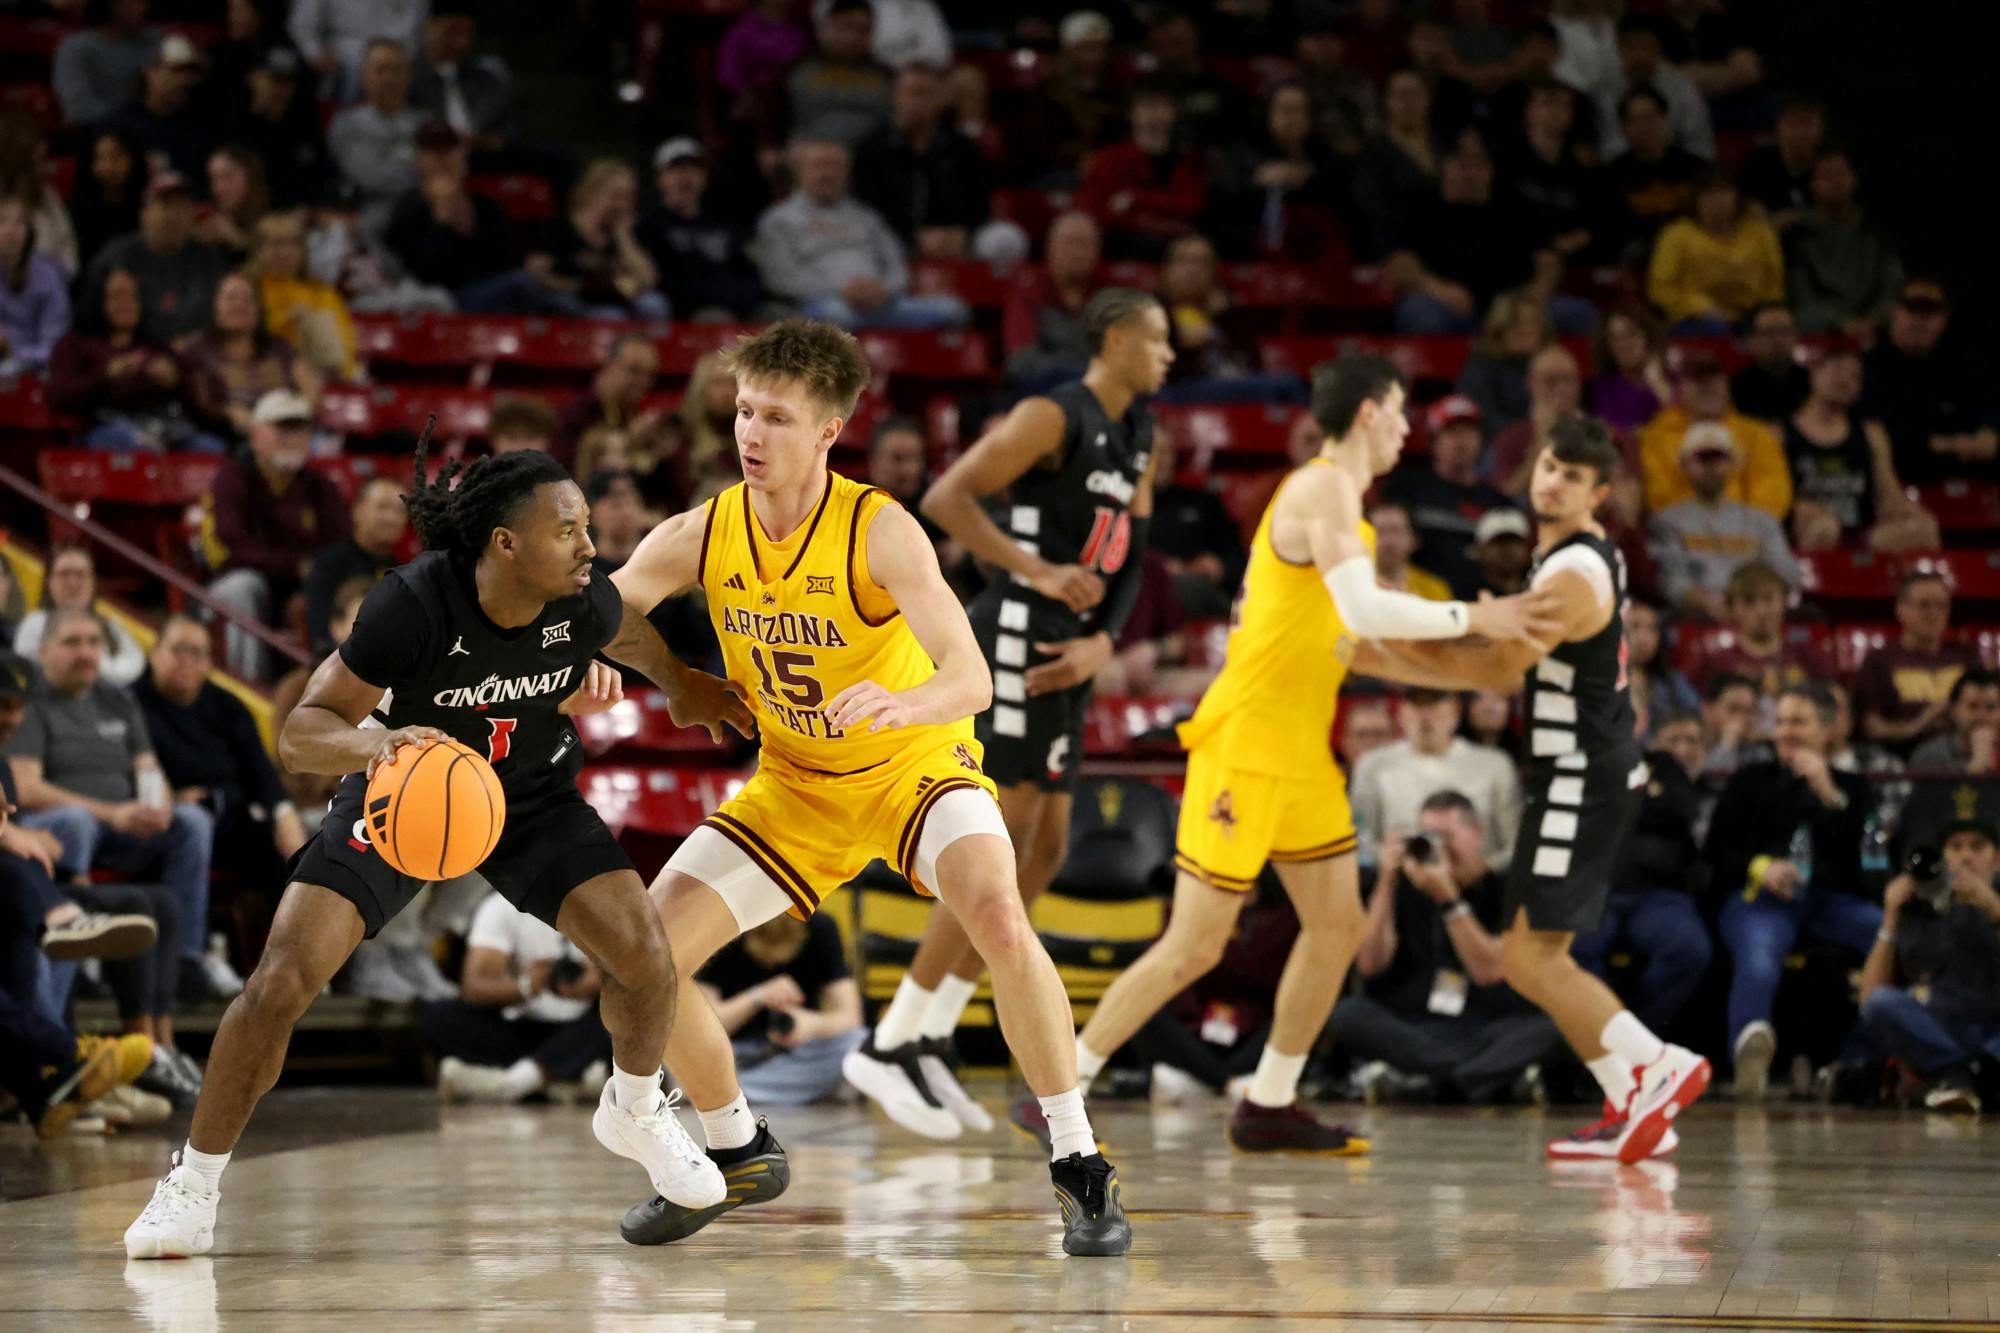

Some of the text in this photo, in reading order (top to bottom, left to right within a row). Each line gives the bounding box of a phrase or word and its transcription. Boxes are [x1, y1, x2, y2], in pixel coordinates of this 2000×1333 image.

[807, 576, 834, 594] XII
[543, 621, 571, 648] XII
[723, 606, 848, 647] ARIZONA
[433, 665, 573, 708] CINCINNATI
[751, 644, 824, 709] 15
[486, 717, 517, 763] 1
